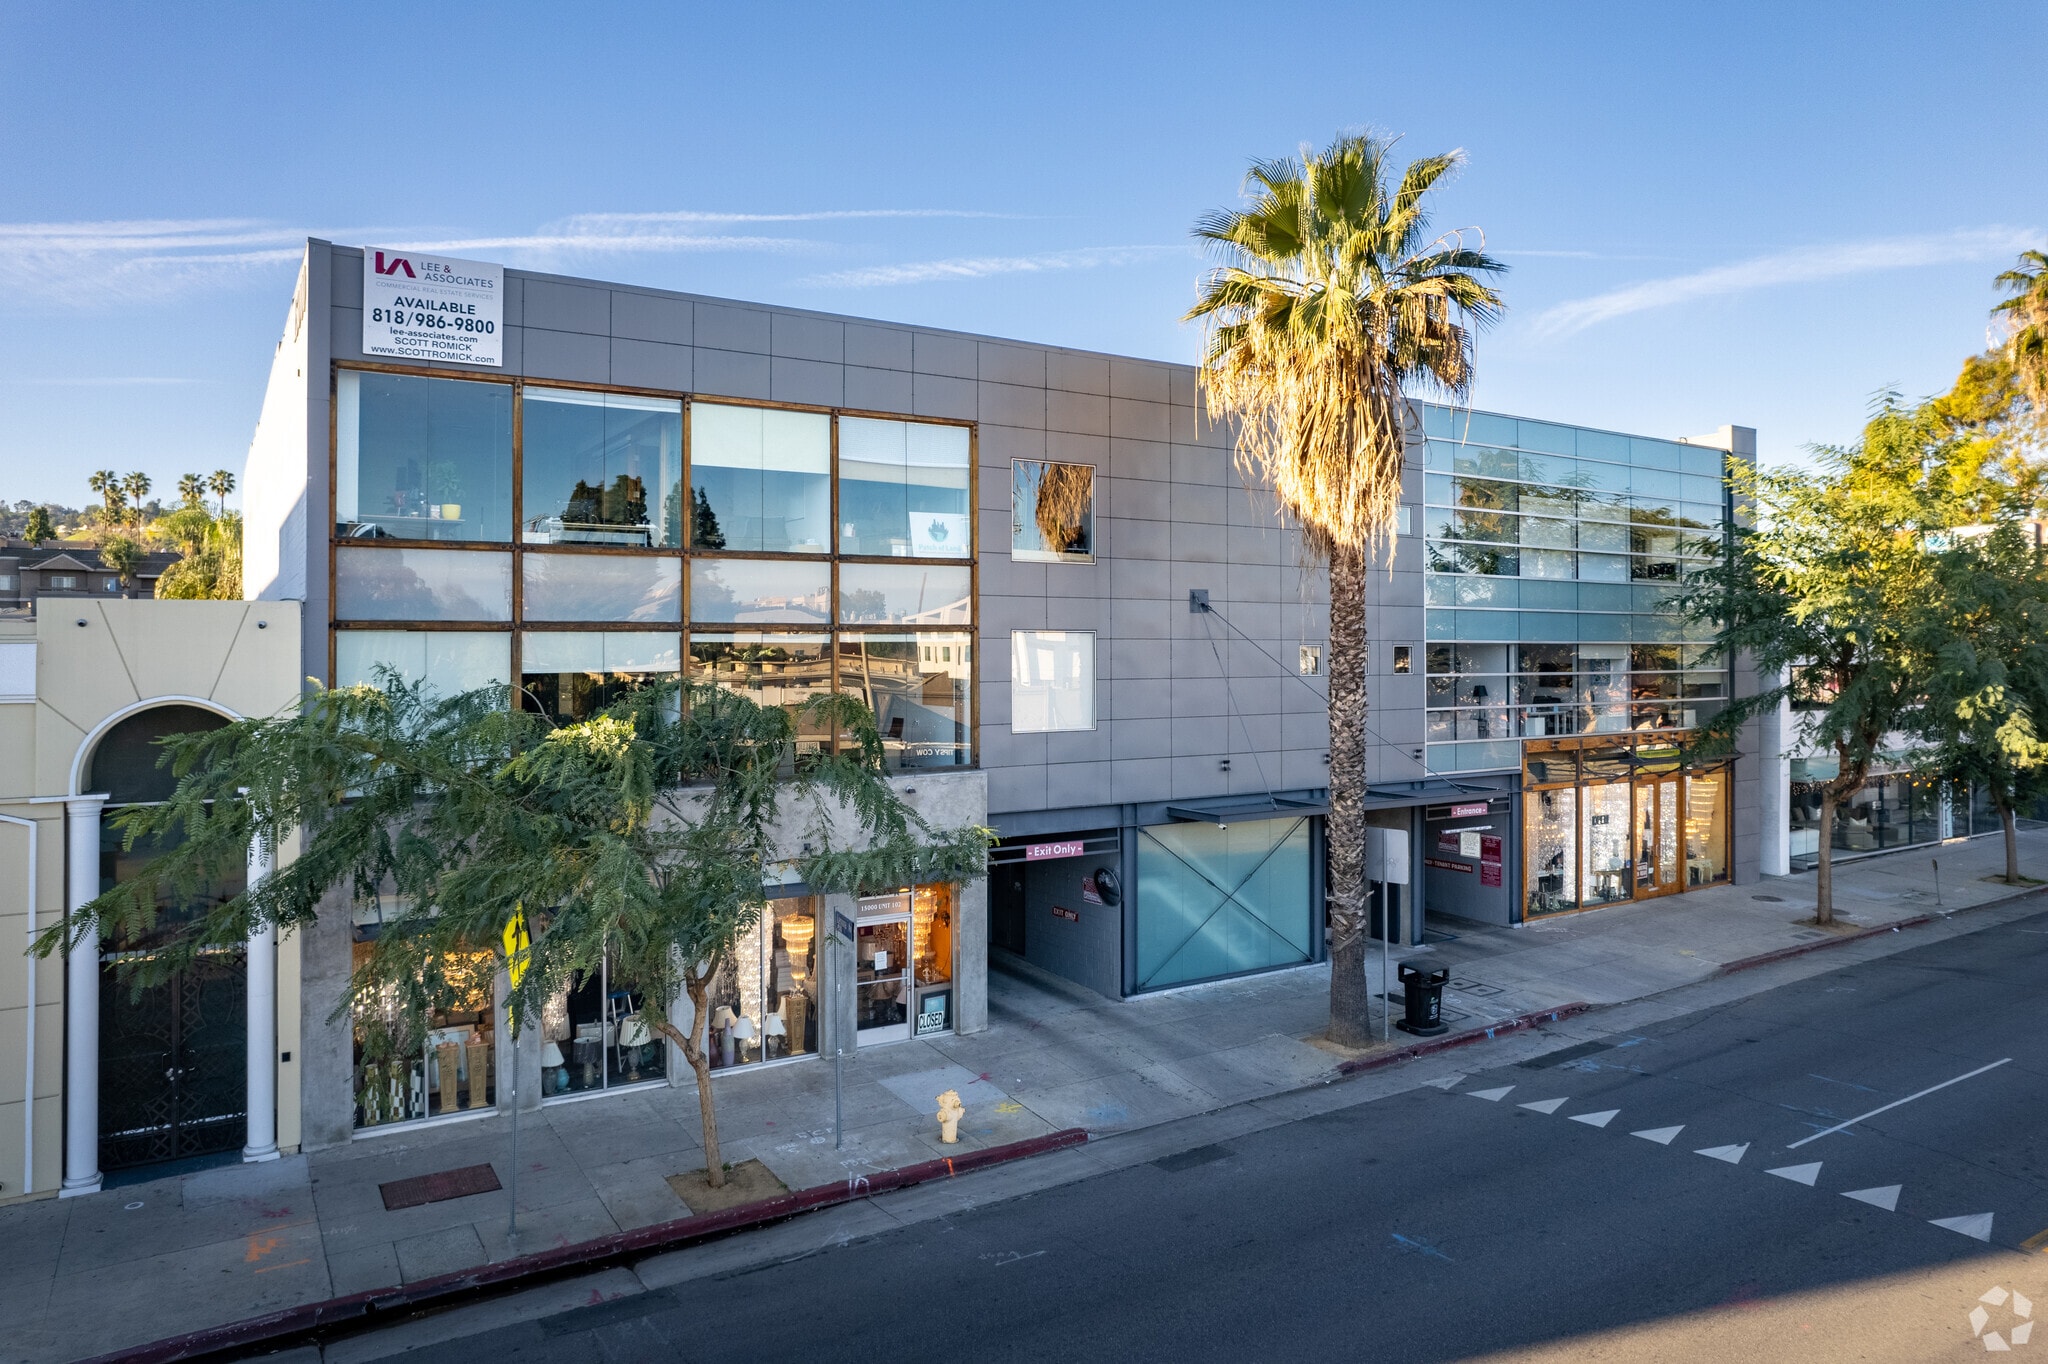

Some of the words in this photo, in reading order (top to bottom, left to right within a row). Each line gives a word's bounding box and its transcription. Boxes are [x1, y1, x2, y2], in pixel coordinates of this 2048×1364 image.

[421, 262, 440, 272] LEE
[443, 264, 451, 273] &
[424, 272, 493, 288] ASSOCIATES
[375, 281, 421, 292] COMMERCIAL
[422, 286, 438, 294] REAL
[440, 288, 462, 297] ESTATE
[464, 291, 494, 300] SERVICES
[394, 296, 476, 315] AVAILABLE
[372, 308, 495, 334] 818/986-9800
[390, 327, 478, 343] lee-associates.com
[394, 337, 429, 347] SCOTT
[431, 340, 472, 351] ROMICK
[371, 346, 495, 364] www.SCOTTROMICK.com
[1456, 807, 1482, 816] Entrance
[1034, 845, 1051, 857] Exit
[1053, 843, 1076, 855] Only
[1451, 863, 1472, 873] PARKING
[878, 902, 890, 910] UNIT
[1053, 907, 1064, 916] EXIT
[1064, 910, 1077, 920] ONLY
[918, 1012, 943, 1029] CLOSED
